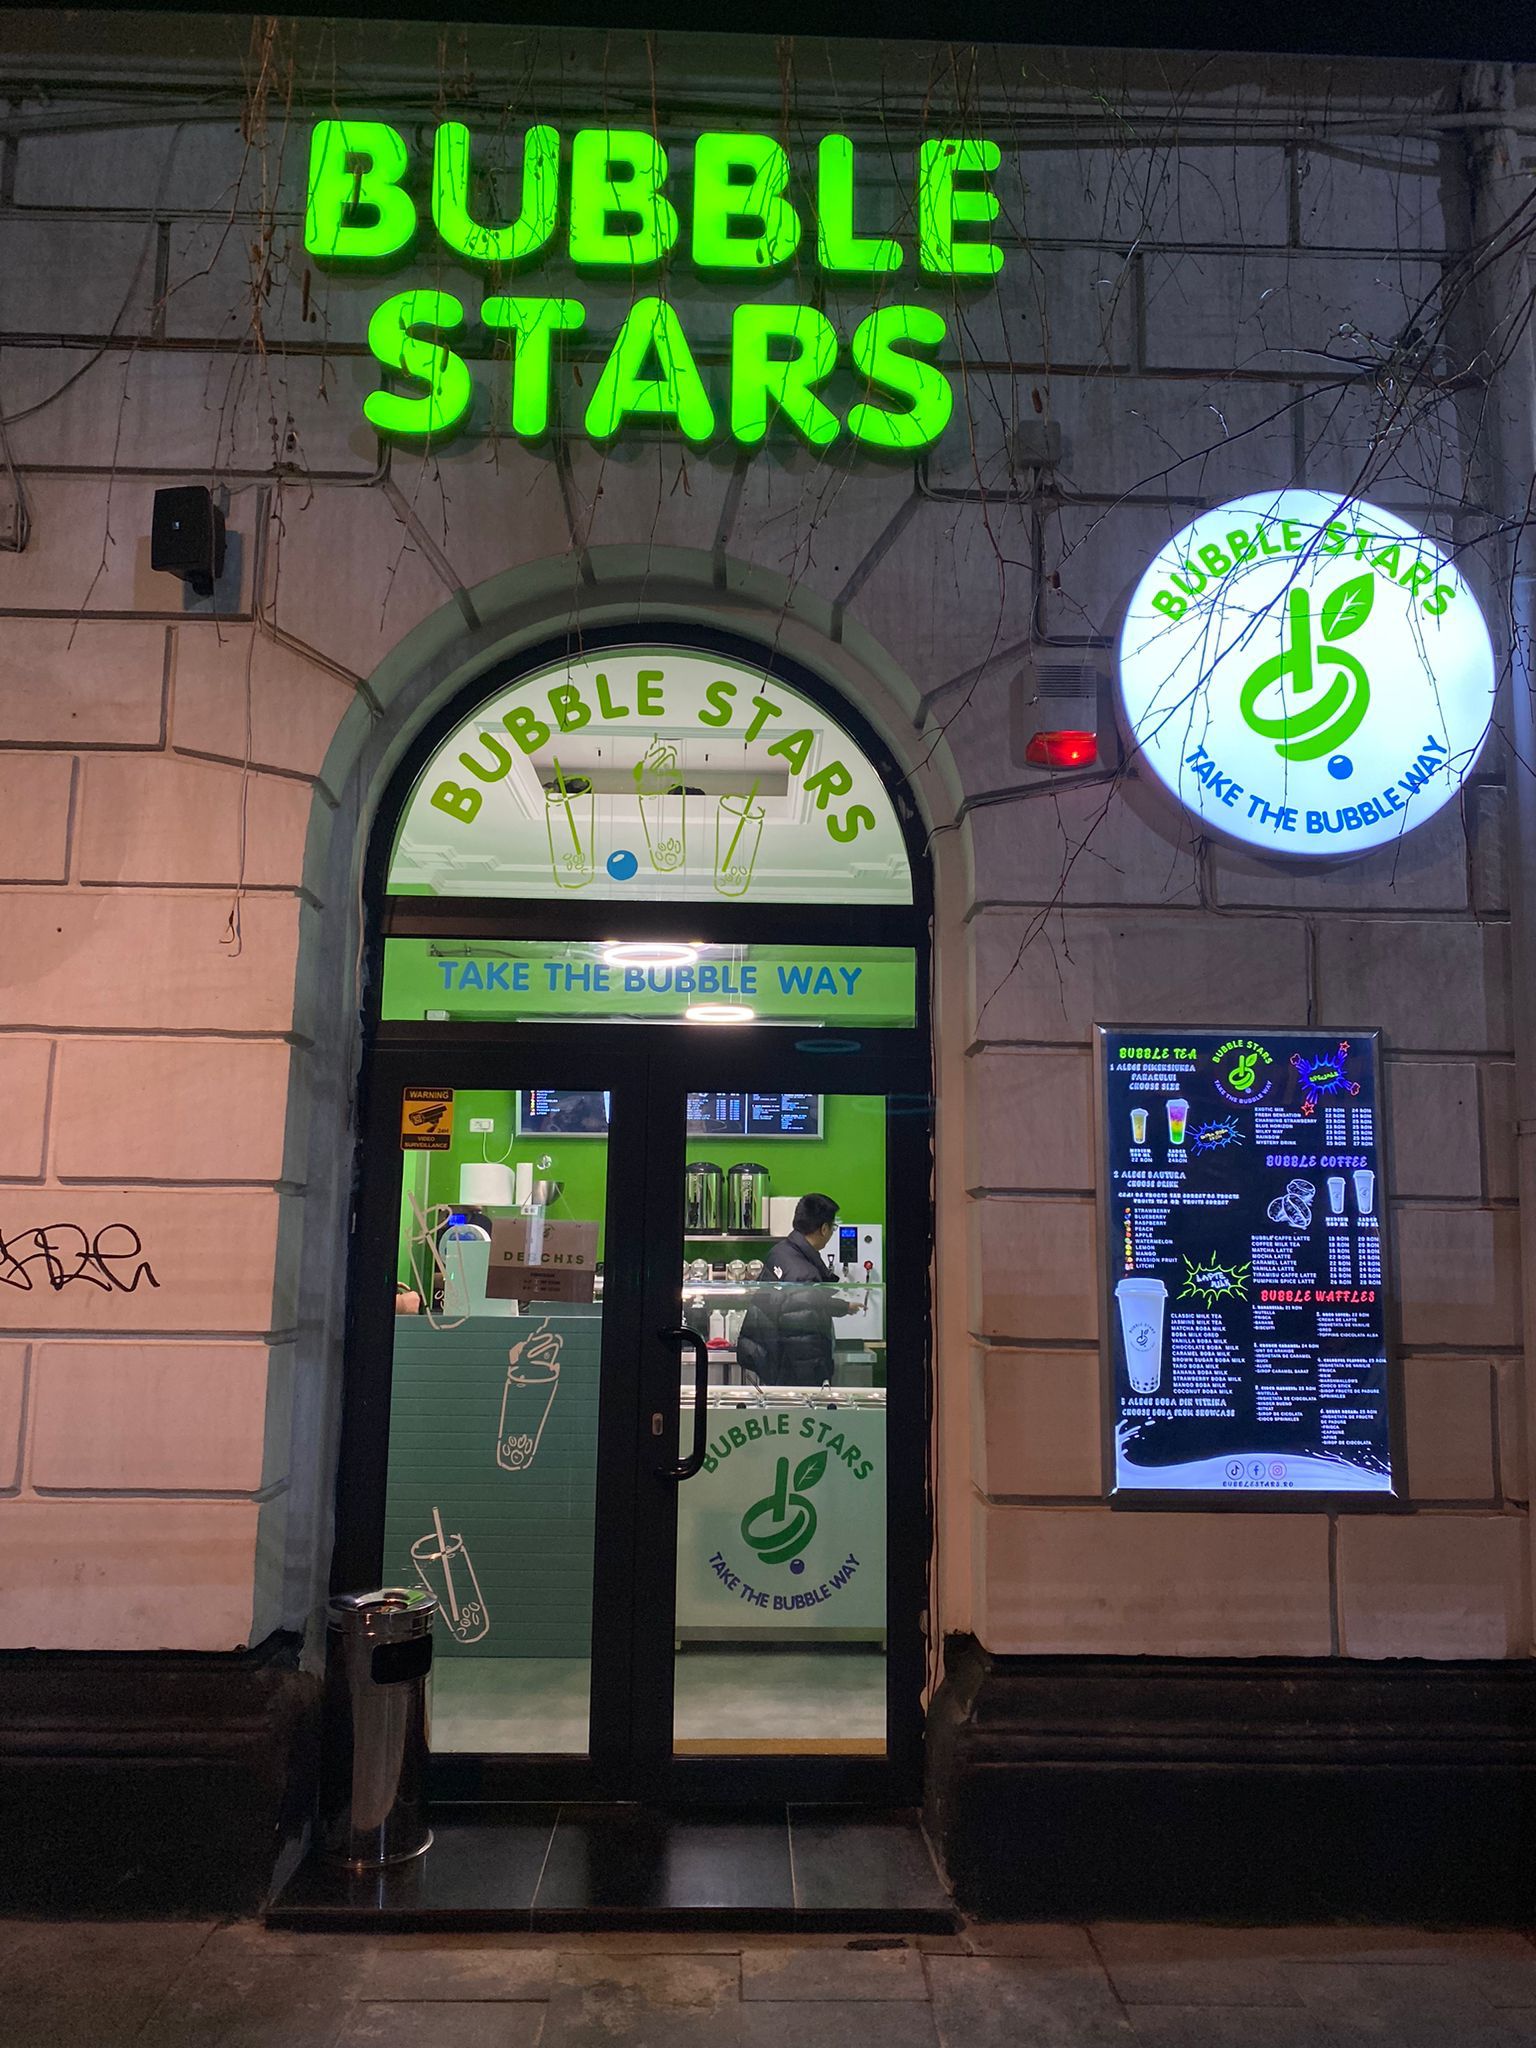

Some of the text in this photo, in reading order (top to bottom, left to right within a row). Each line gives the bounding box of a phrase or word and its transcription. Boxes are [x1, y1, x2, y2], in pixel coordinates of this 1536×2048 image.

[304, 120, 1005, 277] BUBBLE
[363, 289, 953, 448] STARS
[1152, 518, 1456, 621] BUBBLE STARS
[430, 670, 876, 843] BUBBLE STARS
[1186, 734, 1447, 834] TAKE THE BUBBLE WAY
[439, 961, 862, 996] TAKE THE BUBBLE WAY
[1119, 1047, 1198, 1060] BUBBLE TEA
[1212, 1039, 1274, 1065] BUBBLE STARS
[409, 1091, 449, 1099] WARNING
[1129, 1082, 1180, 1091] CHOOSE SIZE
[1214, 1080, 1273, 1104] TAKE THE BUBBLE WAY
[1266, 1155, 1368, 1168] BUBBLE COFFEE
[1127, 1180, 1179, 1188] CHOOSE DRINK
[1195, 1272, 1227, 1283] LAPTE
[1210, 1278, 1231, 1289] MILK
[1261, 1290, 1375, 1303] BUBBLE WAFFLES
[702, 1414, 874, 1480] BUBBLE STARS
[709, 1551, 861, 1611] TAKE THE BUBBLE WAY
